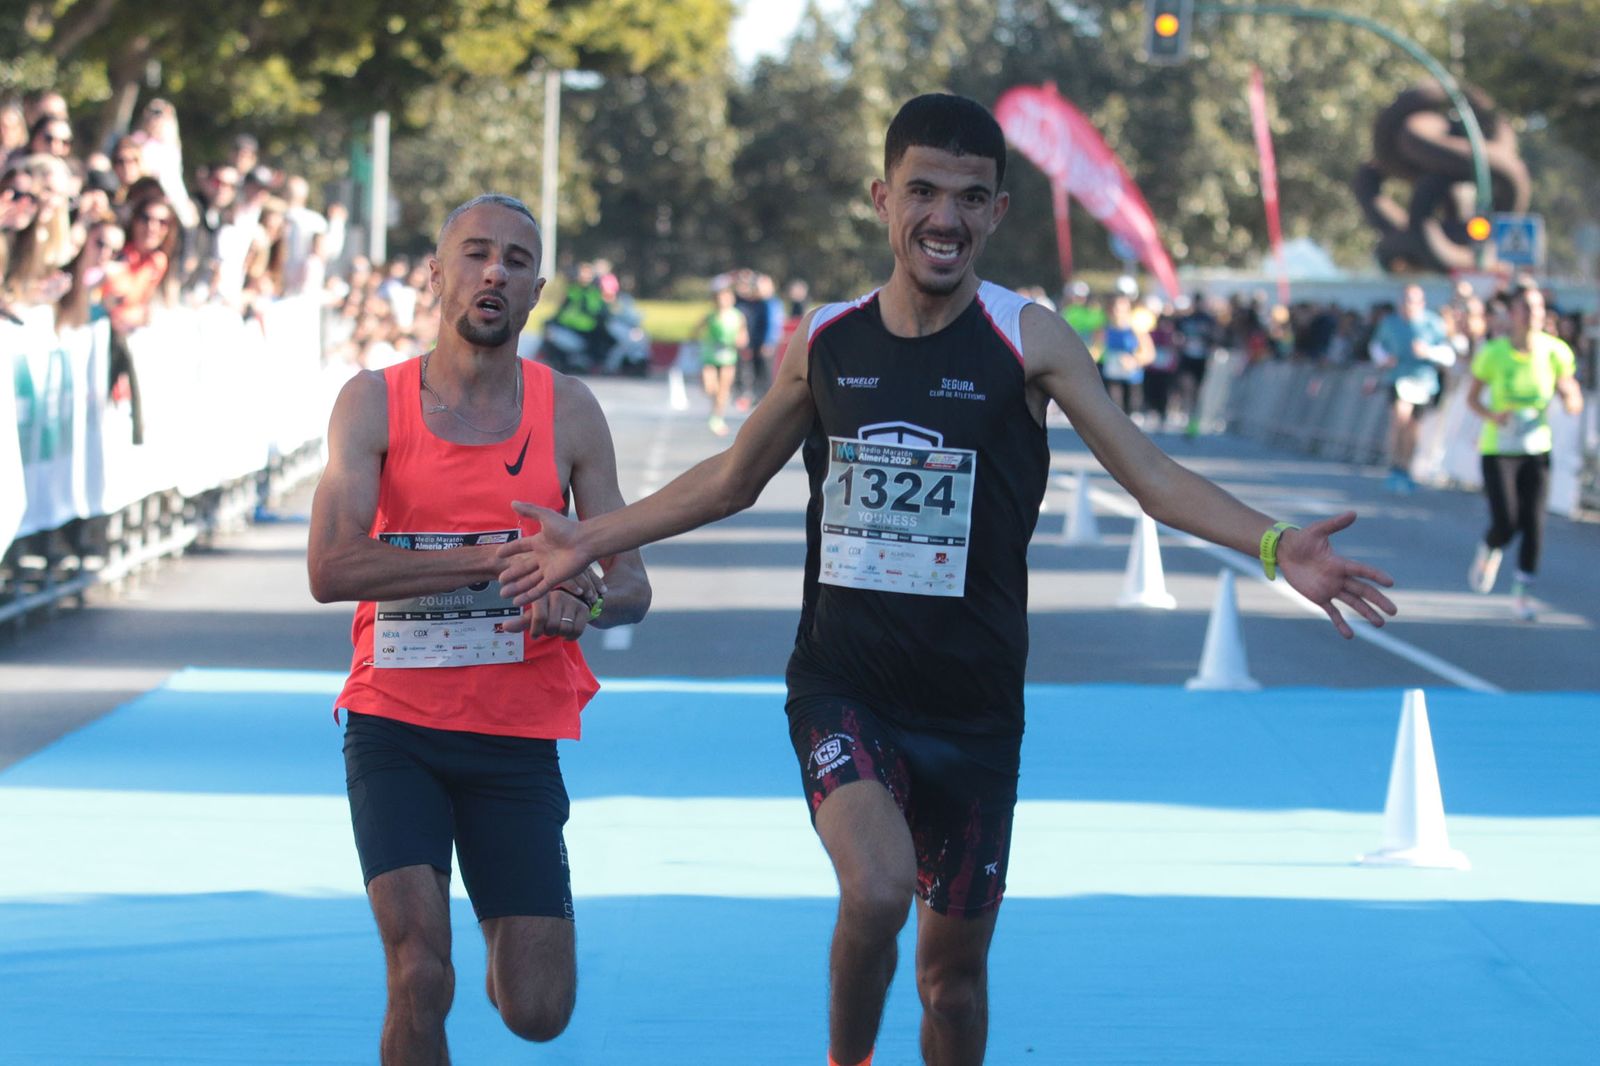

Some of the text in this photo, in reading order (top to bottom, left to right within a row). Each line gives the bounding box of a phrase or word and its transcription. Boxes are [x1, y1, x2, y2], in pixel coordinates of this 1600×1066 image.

[846, 377, 880, 385] TAKELOT
[941, 377, 974, 392] SEGURA
[929, 389, 986, 401] CLUB DE ATLETISMO
[859, 445, 914, 458] Medio Maratón
[858, 452, 890, 463] Almería
[890, 455, 912, 466] 2022
[837, 465, 956, 516] 1324
[857, 511, 918, 527] YOUNESS
[436, 535, 464, 543] Maratón
[414, 542, 442, 550] Almería
[419, 595, 474, 607] ZOUHAIR
[382, 629, 429, 639] NEXA CDX
